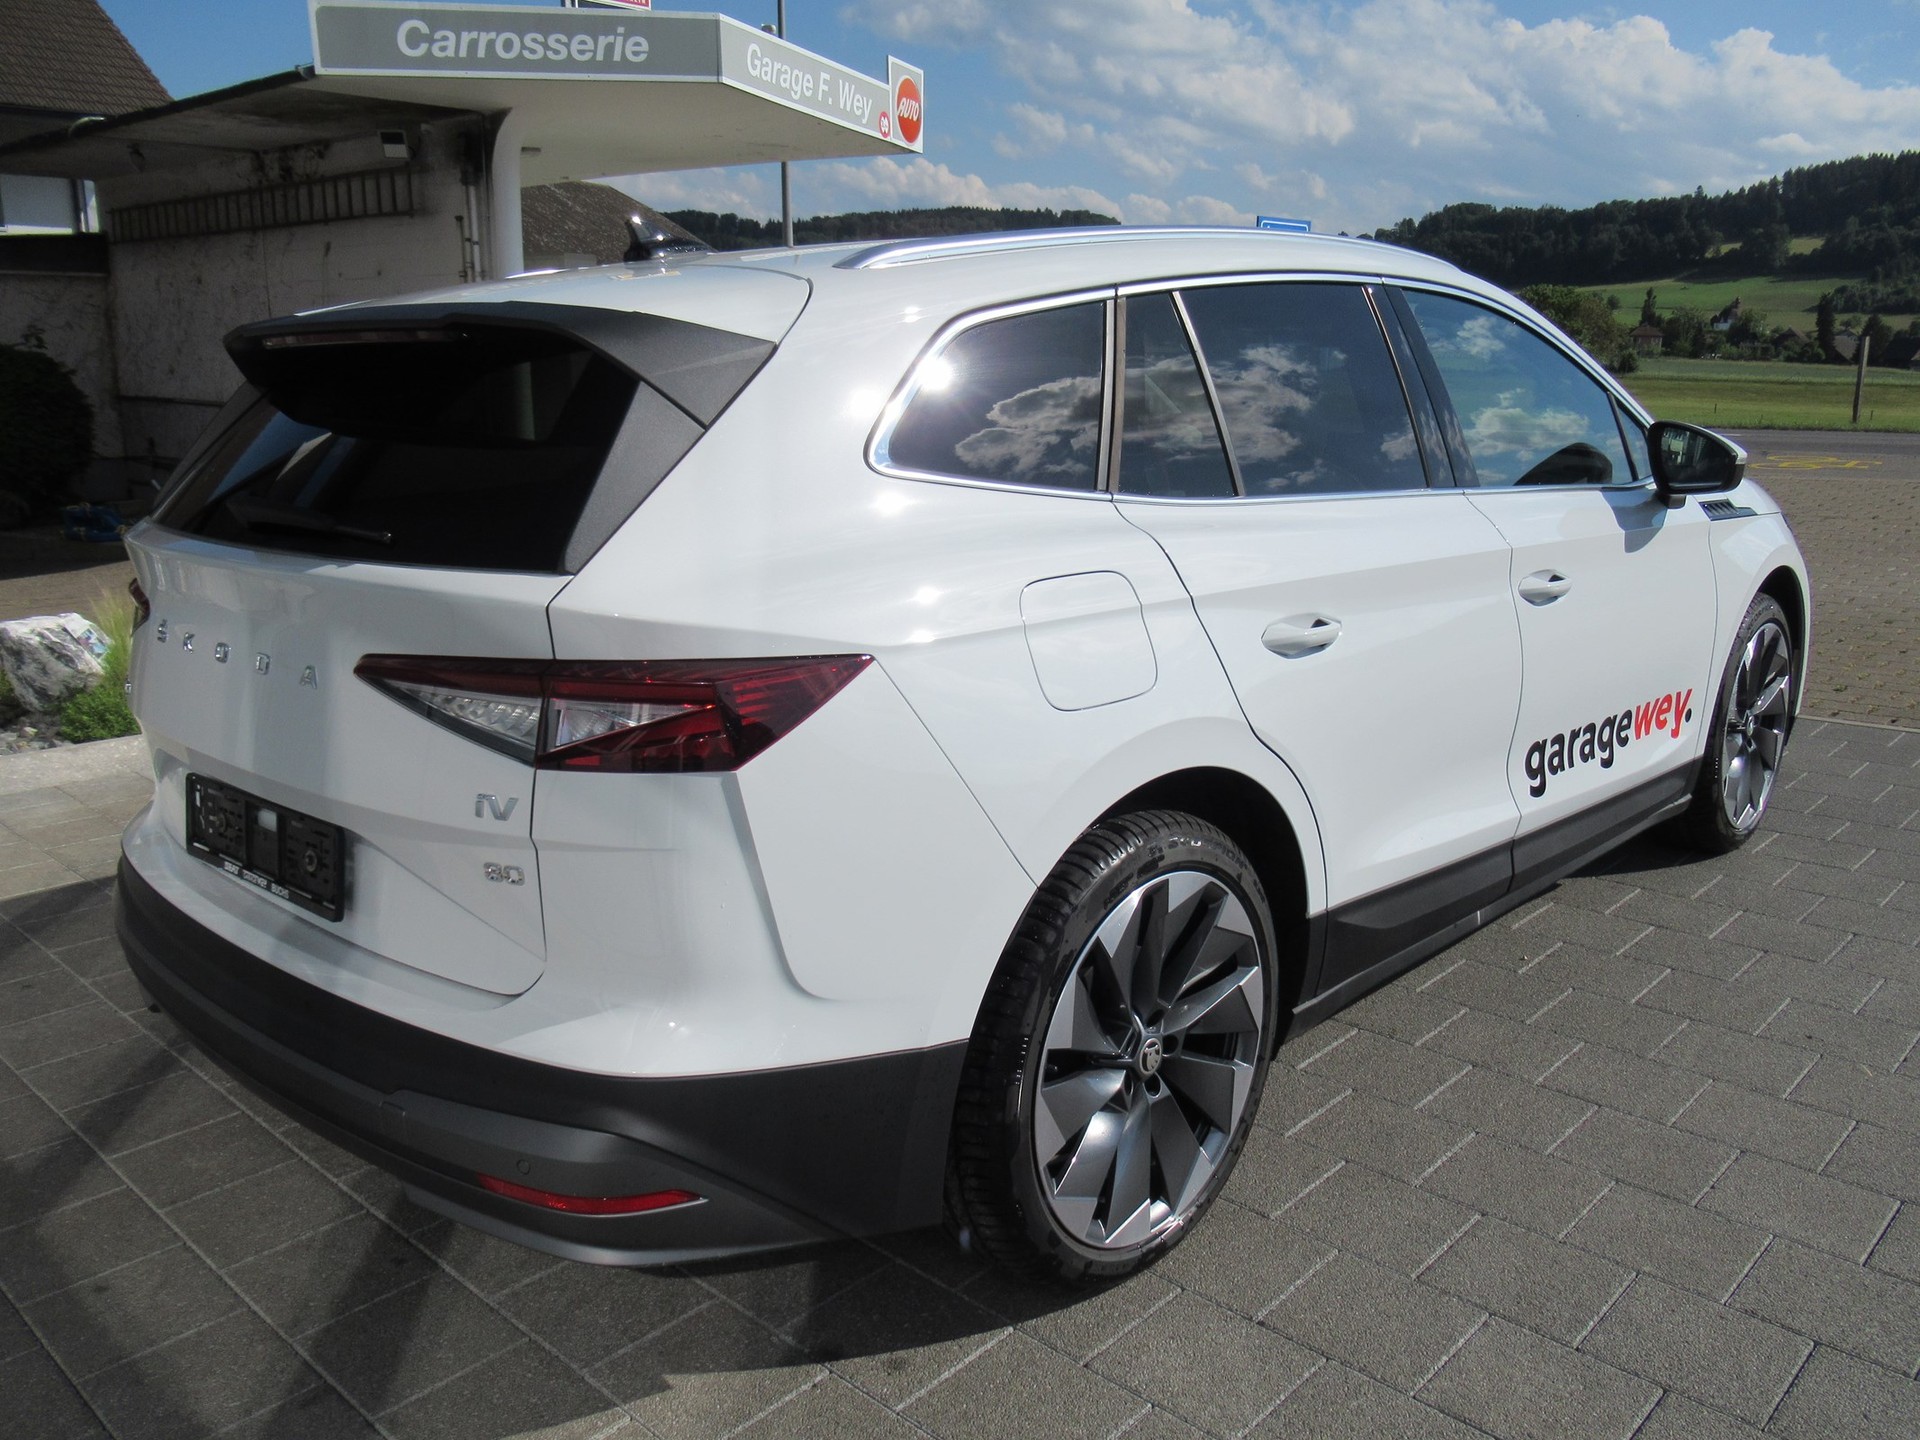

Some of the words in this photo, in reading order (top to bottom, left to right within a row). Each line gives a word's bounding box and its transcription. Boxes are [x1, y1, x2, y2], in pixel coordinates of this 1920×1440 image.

[396, 19, 650, 63] Carrosserie
[746, 43, 814, 100] Garage
[817, 71, 833, 105] F.
[839, 79, 873, 124] Wey
[898, 97, 920, 122] AUTO
[483, 862, 525, 886] 80
